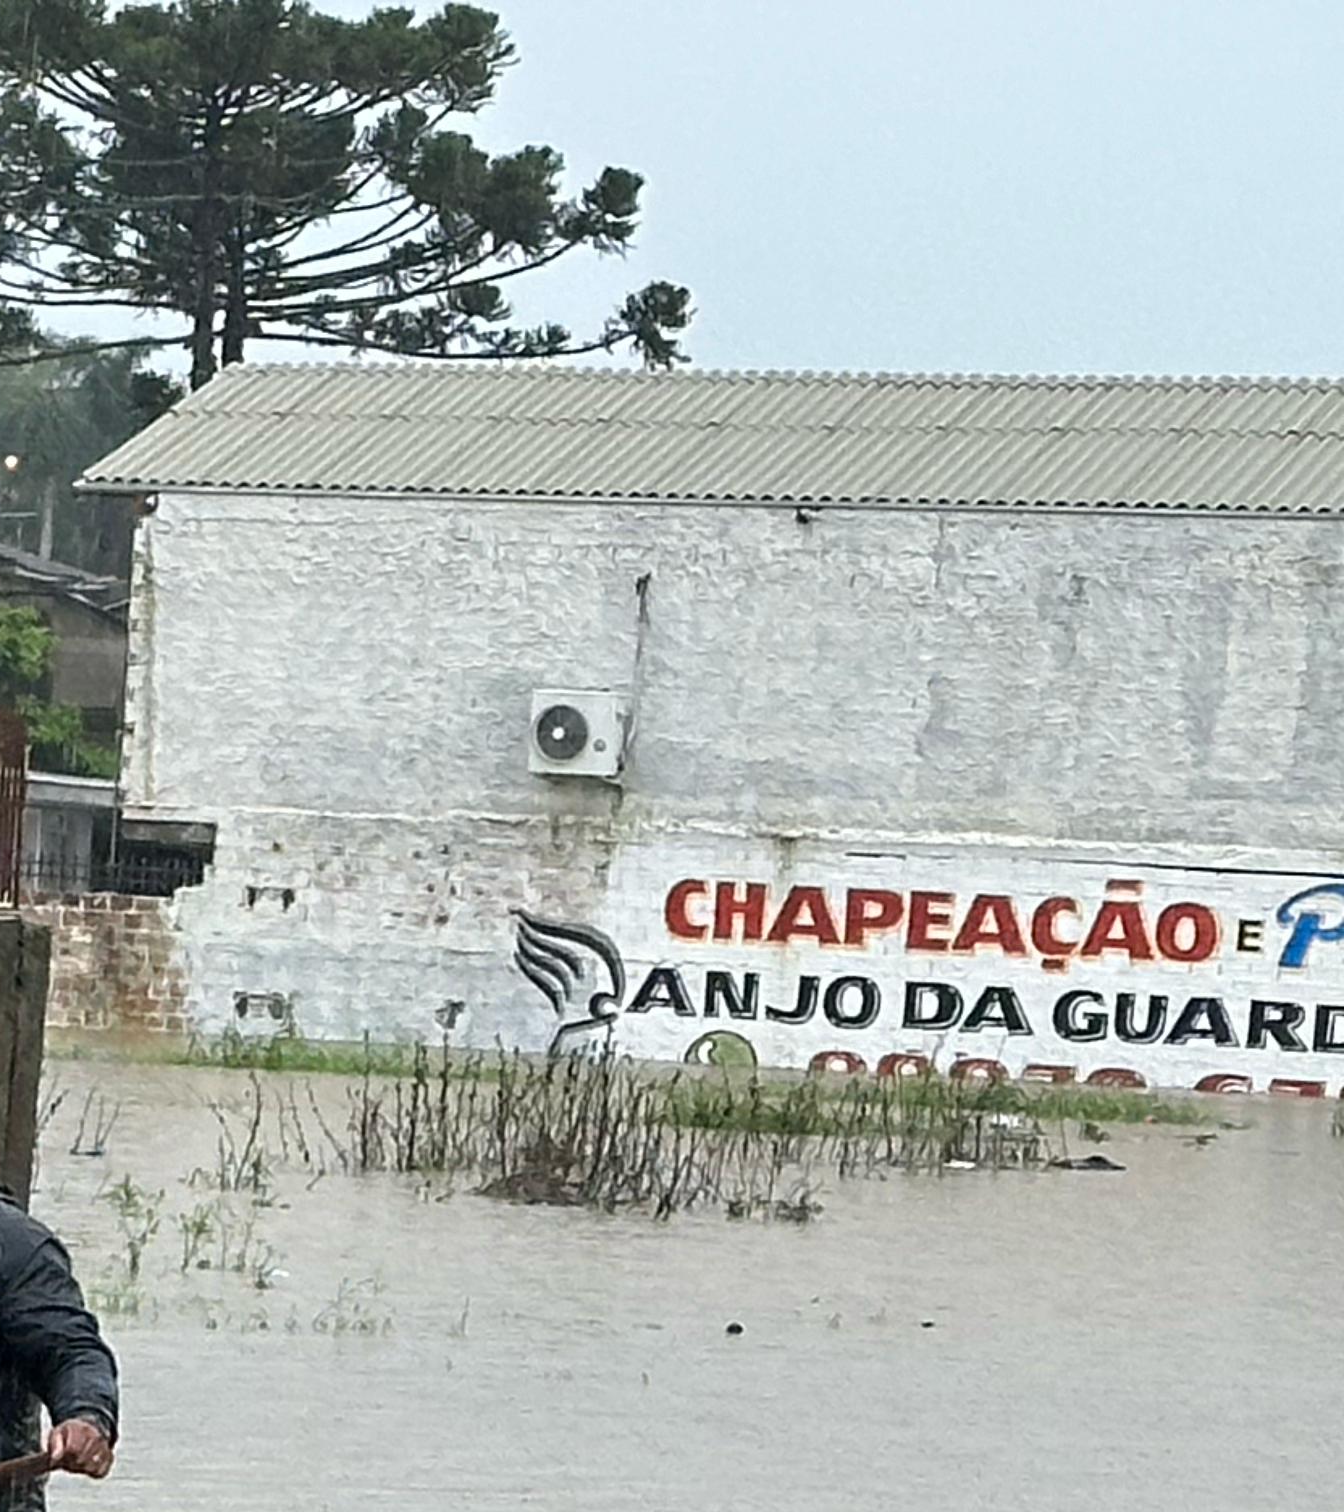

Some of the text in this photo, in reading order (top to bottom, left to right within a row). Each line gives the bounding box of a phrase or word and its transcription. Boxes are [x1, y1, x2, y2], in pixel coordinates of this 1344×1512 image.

[664, 878, 1344, 970] CHAPEAÇÃO E P
[626, 966, 1344, 1054] ANJO DA GUARD
